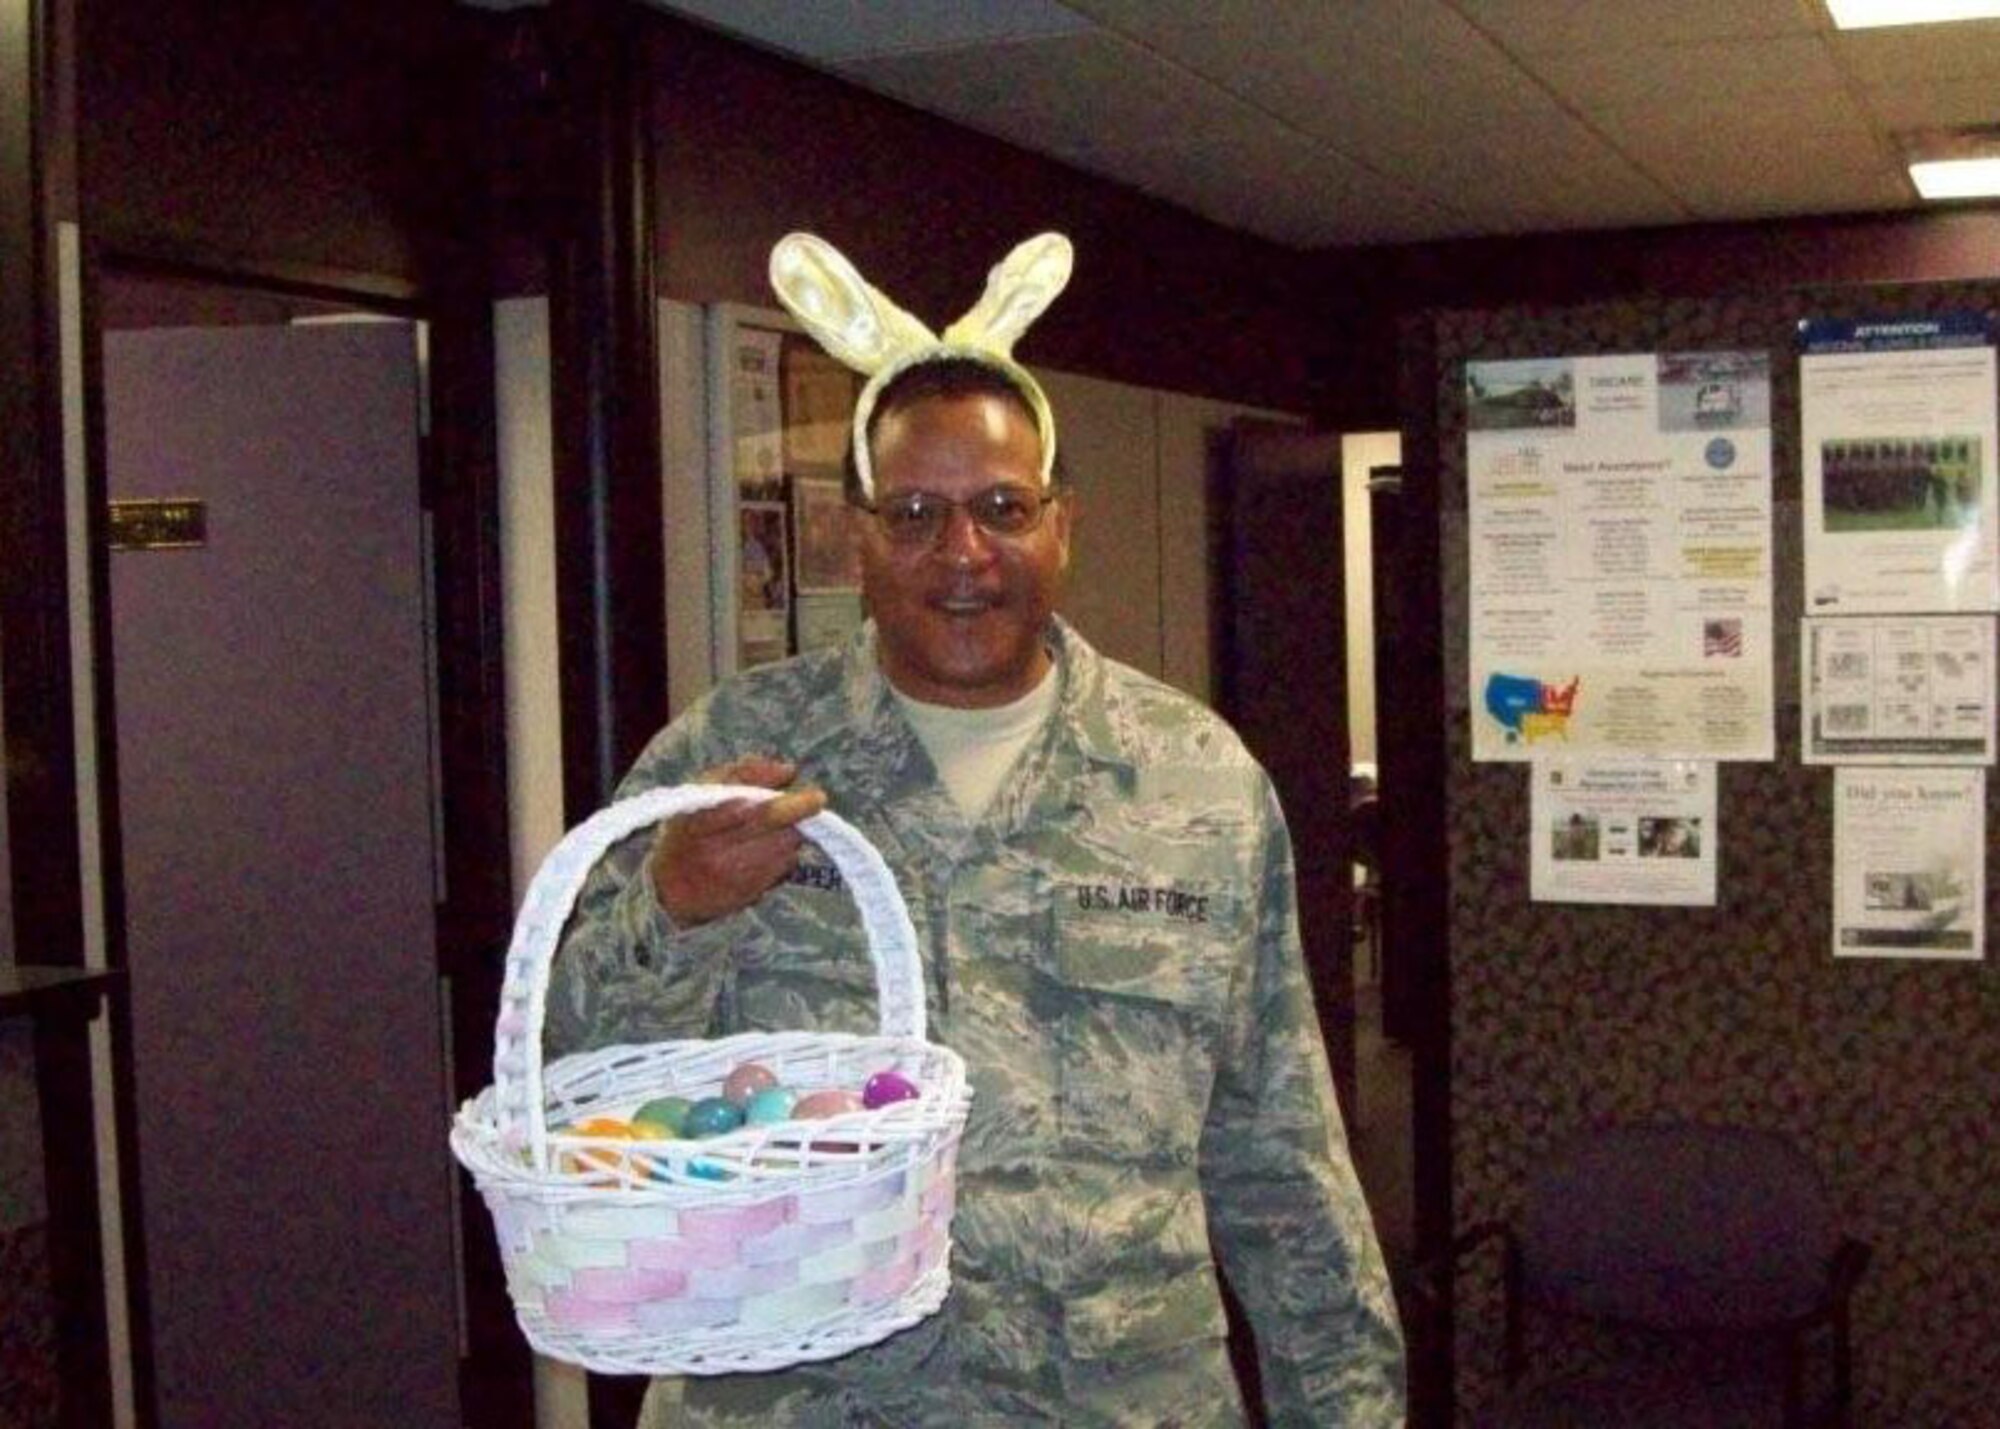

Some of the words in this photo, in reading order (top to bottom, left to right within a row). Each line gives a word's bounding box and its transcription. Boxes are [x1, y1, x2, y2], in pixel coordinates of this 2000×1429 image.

[1854, 322, 1940, 338] ATTENTION
[1846, 784, 1877, 799] Did
[1117, 886, 1150, 913] AIR
[1154, 889, 1209, 922] FORCE
